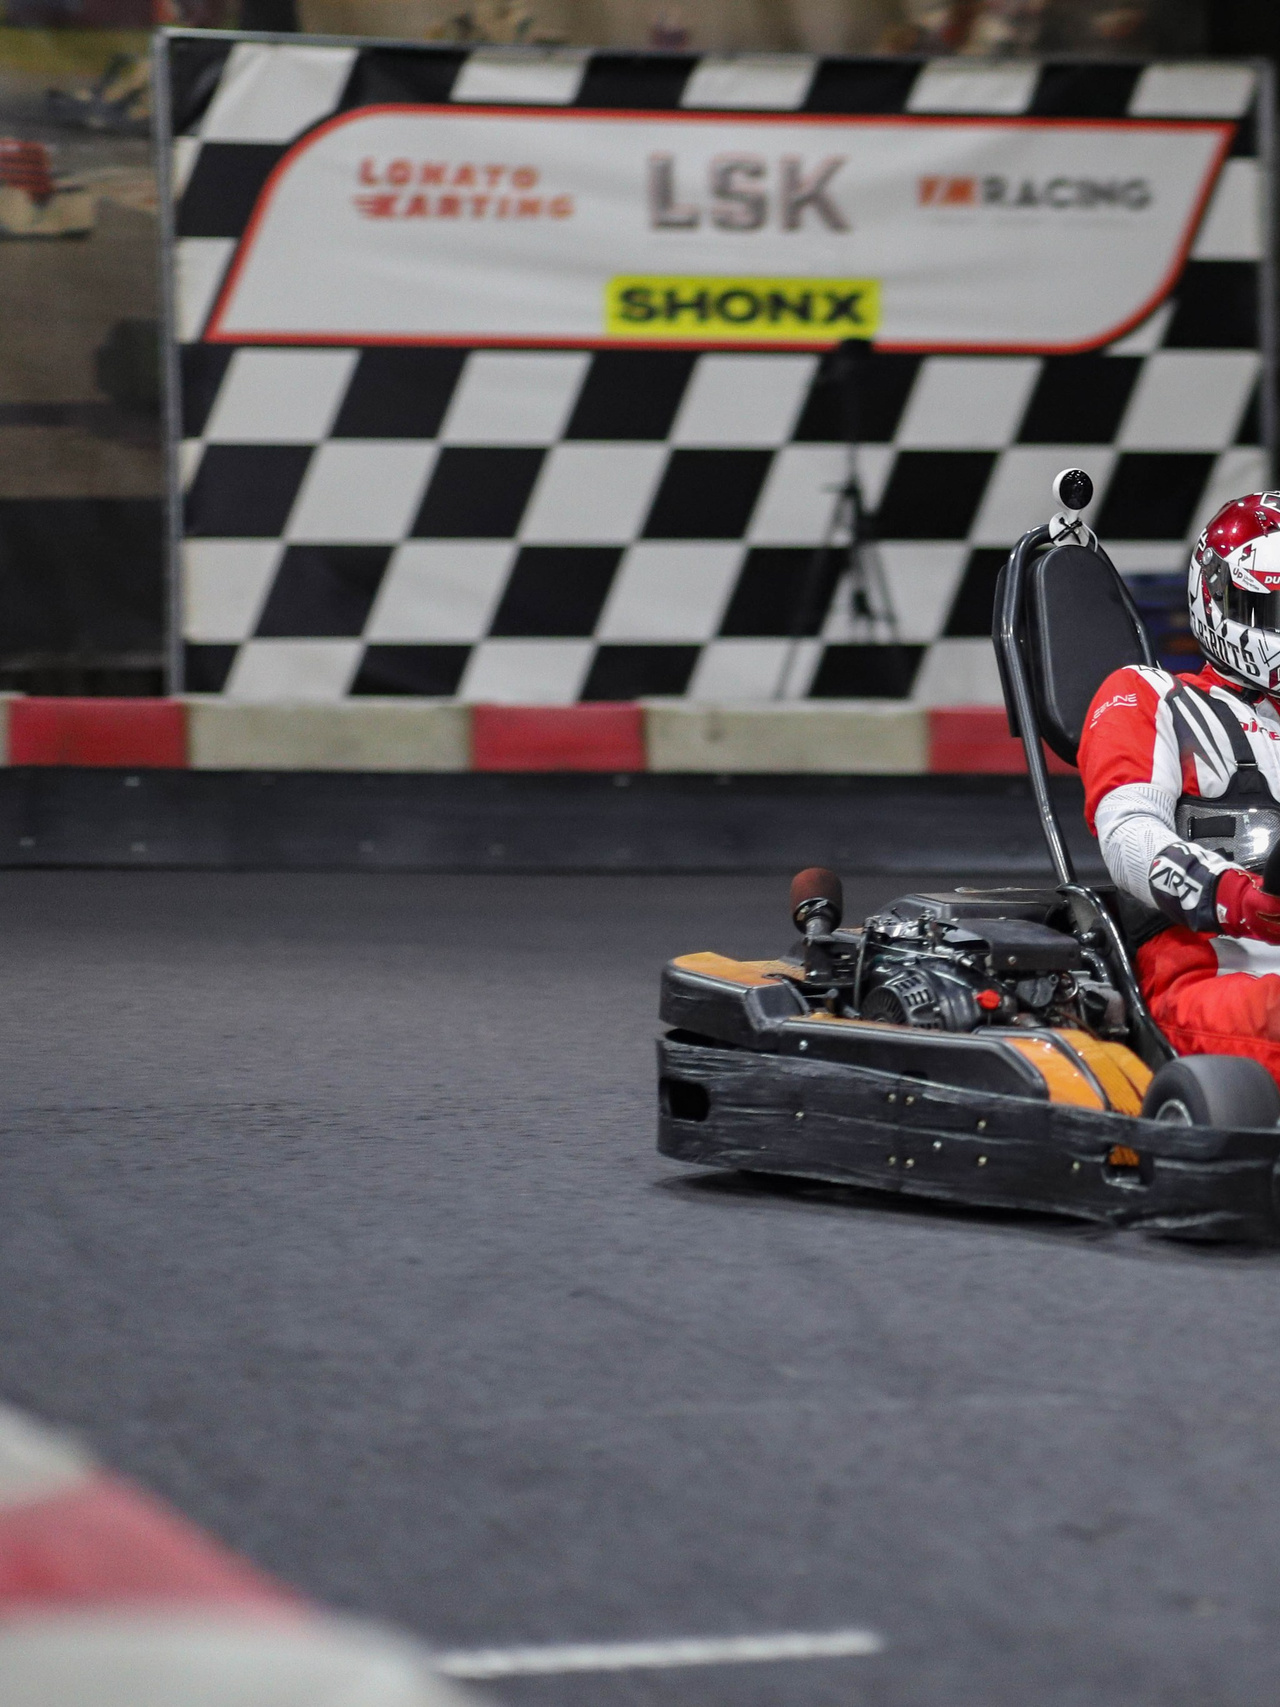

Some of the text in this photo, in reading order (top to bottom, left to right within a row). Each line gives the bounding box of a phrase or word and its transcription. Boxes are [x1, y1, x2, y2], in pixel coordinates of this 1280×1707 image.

[648, 151, 853, 232] LSK
[983, 174, 1153, 212] RACING
[619, 287, 866, 325] SHONX
[1150, 866, 1199, 902] ART
